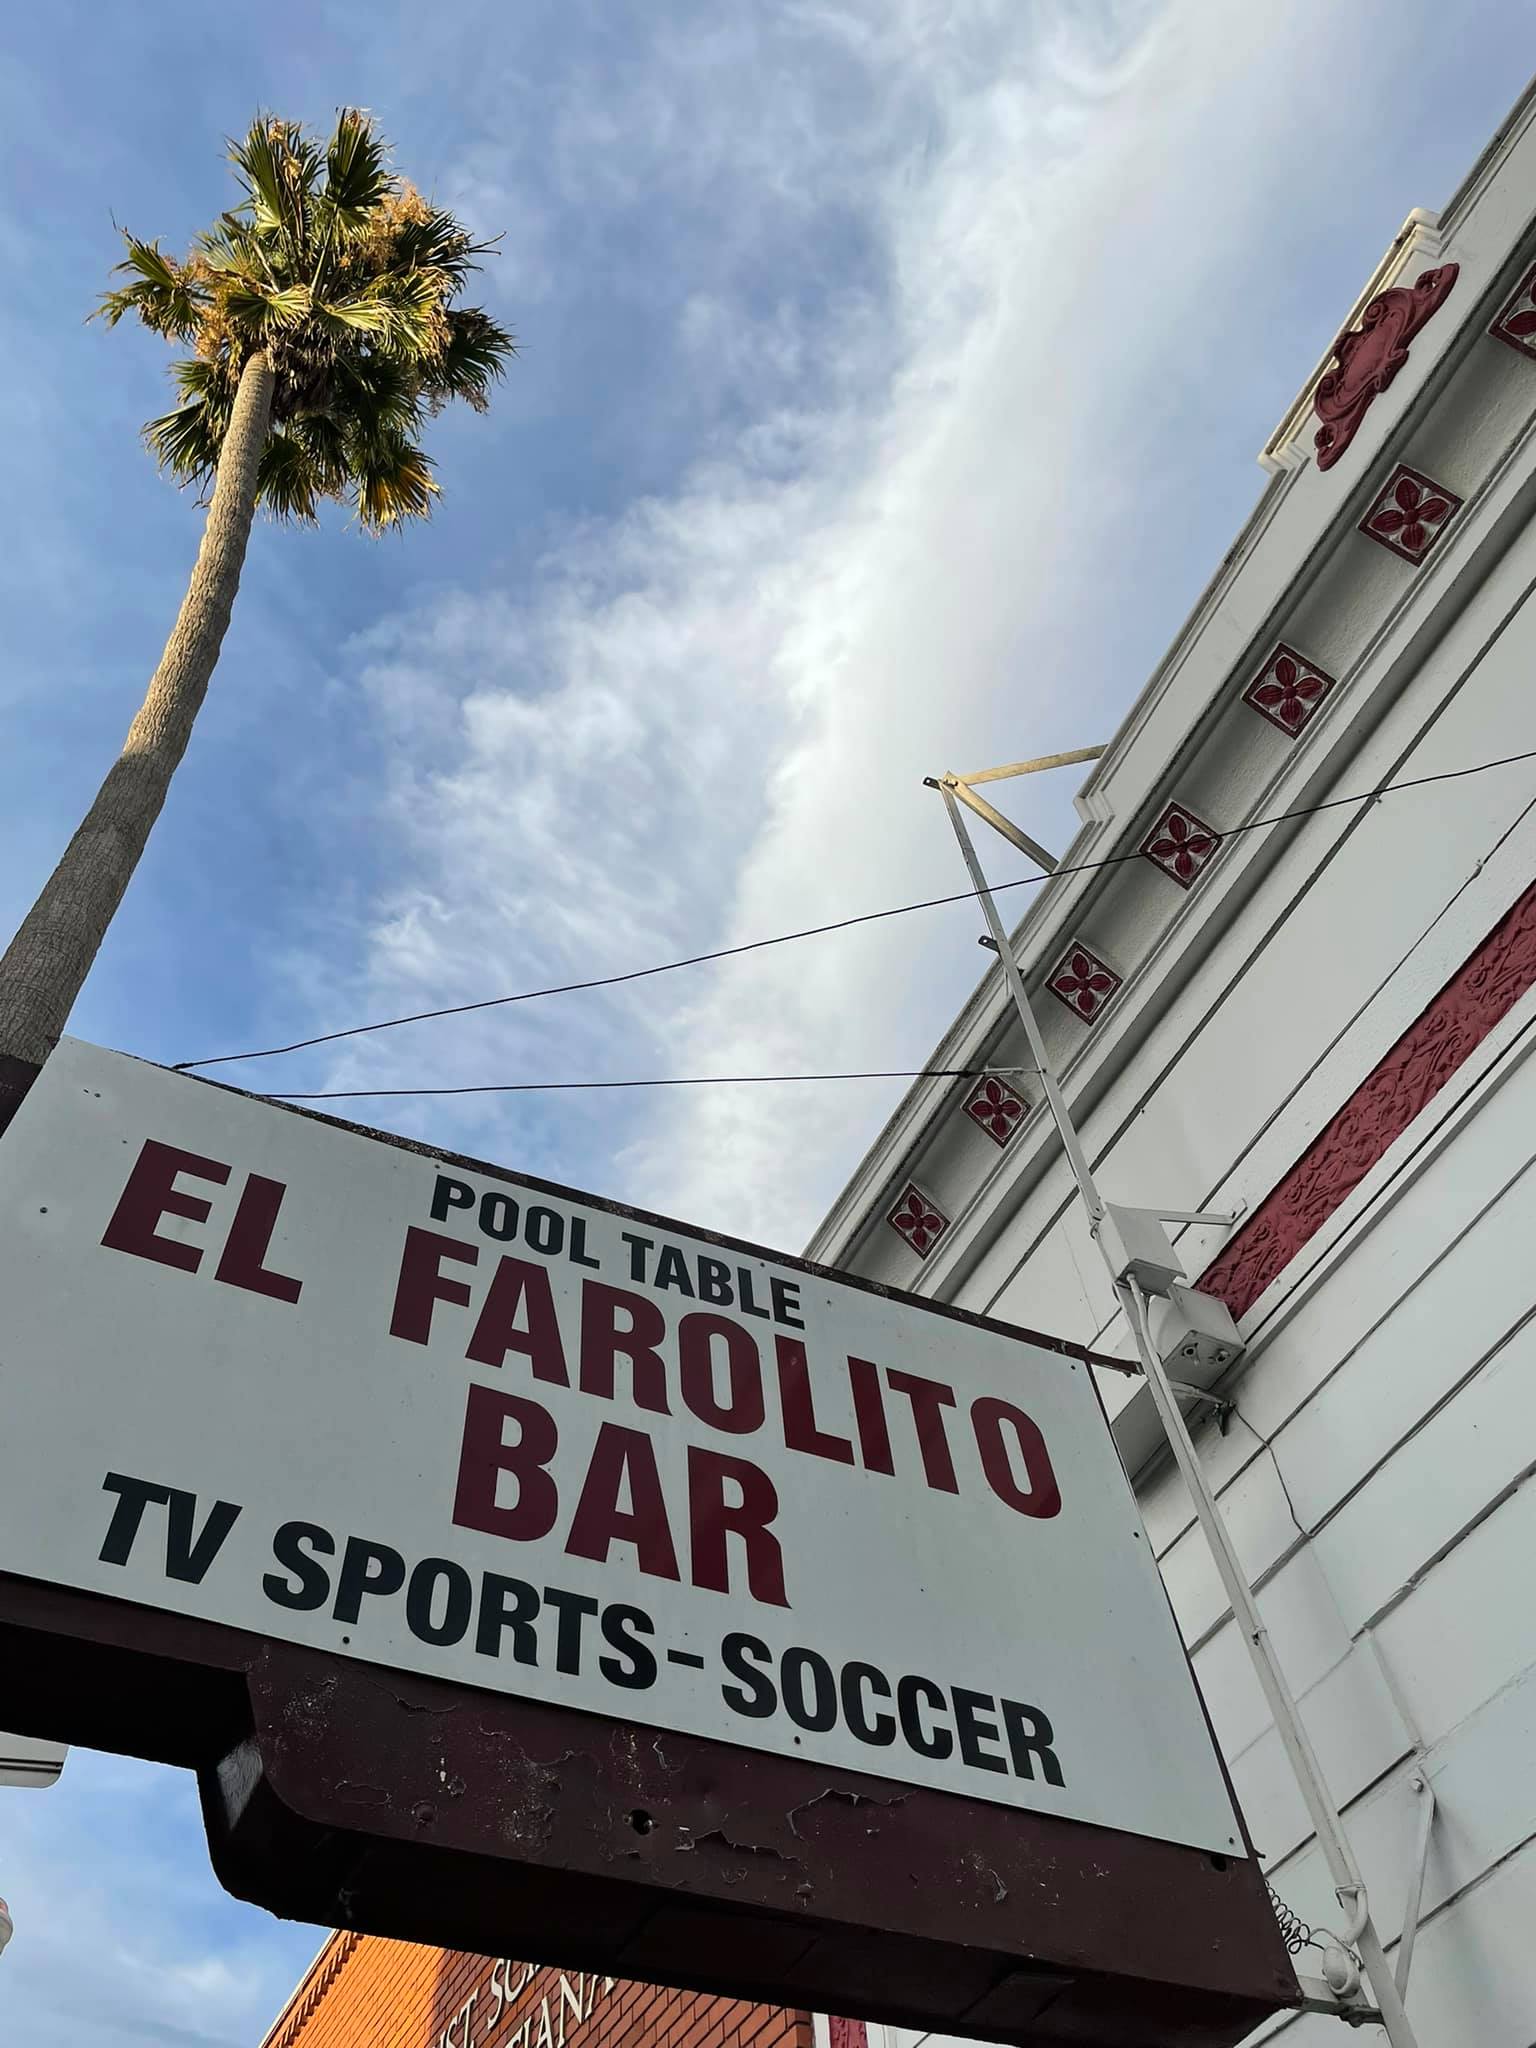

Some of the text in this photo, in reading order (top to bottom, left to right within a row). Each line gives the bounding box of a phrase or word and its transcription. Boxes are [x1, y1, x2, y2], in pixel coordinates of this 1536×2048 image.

[100, 1138, 1063, 1520] EL FAROLITO
[430, 1174, 806, 1331] POOL TABLE
[98, 1471, 243, 1585] TV
[451, 1382, 793, 1610] BAR
